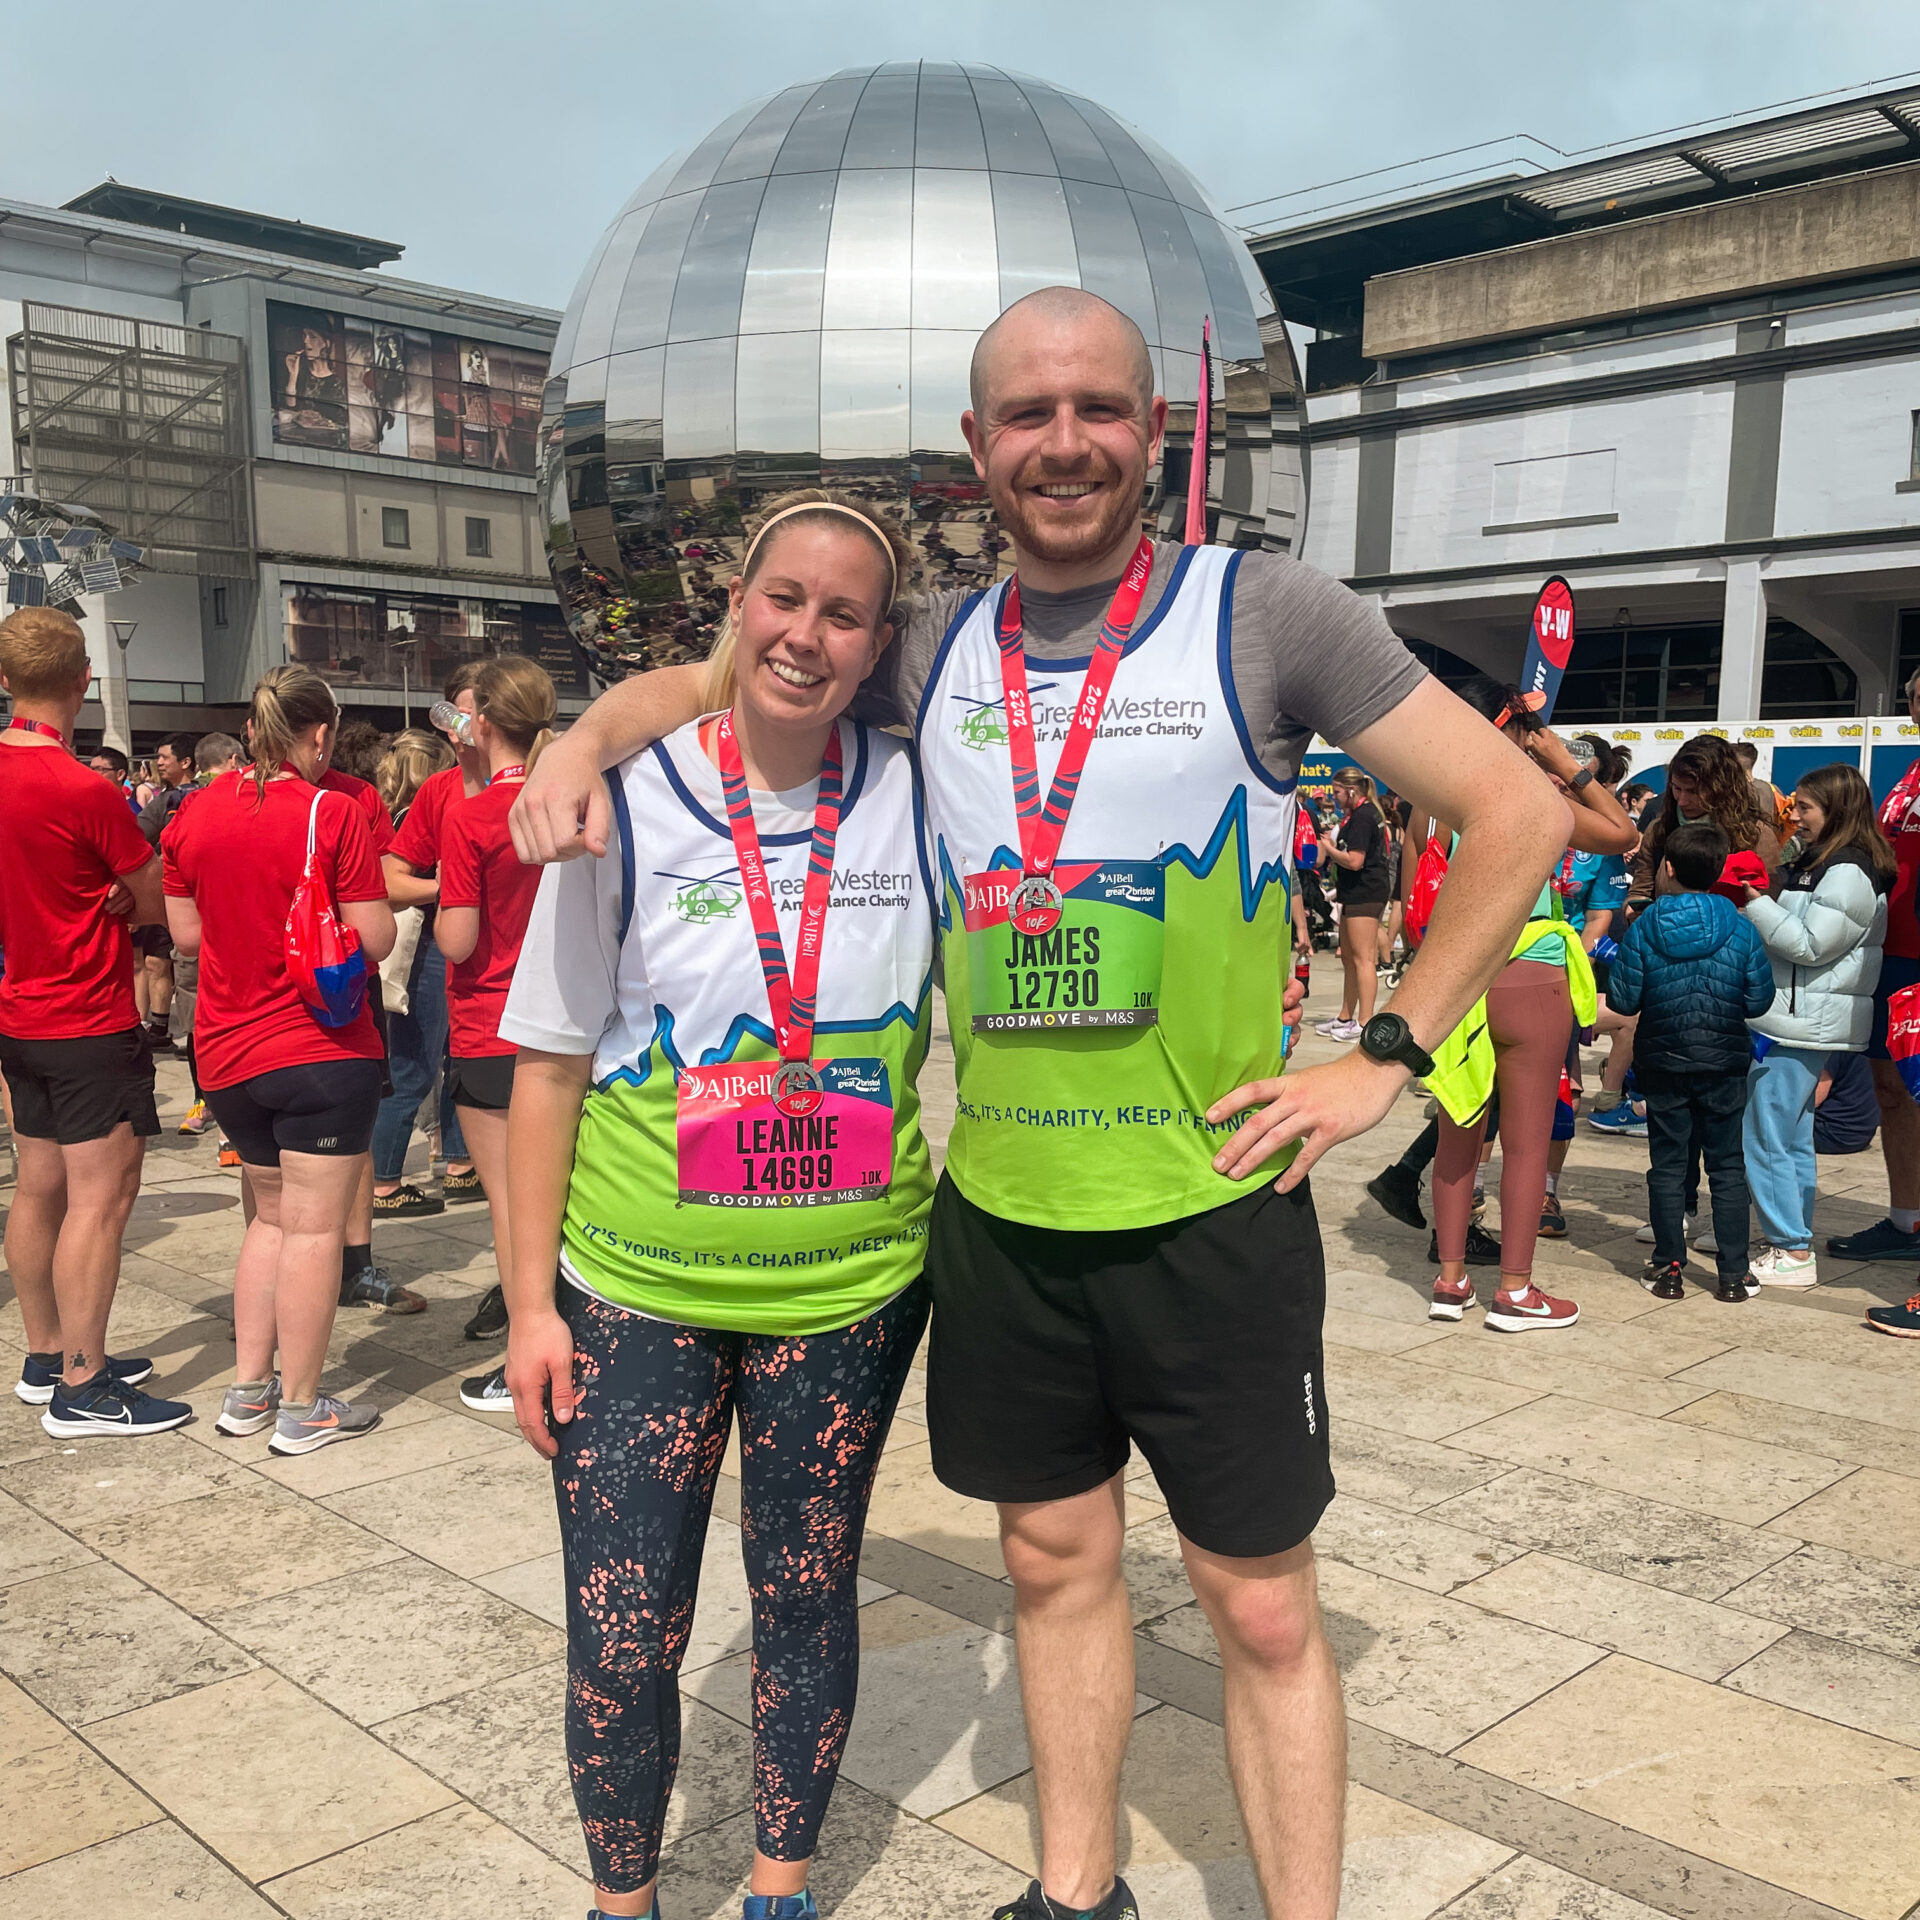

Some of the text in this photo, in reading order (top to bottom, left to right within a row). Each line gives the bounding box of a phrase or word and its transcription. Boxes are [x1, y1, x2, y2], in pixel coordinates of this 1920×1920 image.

[1009, 689, 1027, 727] 2023
[1030, 697, 1206, 725] Grea Western
[1079, 685, 1102, 729] 2023
[1034, 728, 1048, 742] ir
[1147, 722, 1203, 740] Charity
[1300, 763, 1332, 777] hat's
[743, 850, 763, 889] AJBell
[770, 868, 912, 896] rea Western
[1105, 873, 1133, 884] AJBell
[869, 894, 910, 911] Charity
[976, 884, 1026, 914] AJB
[1105, 887, 1155, 897] great bristol
[1026, 915, 1048, 930] 10K
[802, 916, 819, 957] AJBell
[1005, 927, 1100, 969] JAMES
[1009, 968, 1099, 1010] 12730
[1133, 992, 1152, 1008] 10K
[987, 1012, 1134, 1029] GOODMOVE by M&S
[837, 1067, 861, 1078] AJBell
[837, 1079, 880, 1089] great bristol
[703, 1074, 771, 1102] AJBell
[789, 1097, 811, 1112] 10K
[1005, 1107, 1013, 1120] A
[1016, 1106, 1111, 1131] CHARITY,
[1117, 1106, 1171, 1126] KEEP
[1178, 1108, 1188, 1125] IT
[736, 1115, 839, 1154] LEANNE
[742, 1154, 832, 1191] 14699
[861, 1170, 882, 1185] 10K
[709, 1189, 863, 1207] GOODMOVE by M&S
[623, 1239, 689, 1268] YOURS,
[731, 1253, 742, 1264] A
[747, 1247, 843, 1268] CHARITY,
[849, 1235, 893, 1256] KEEP
[897, 1229, 908, 1245] IT
[1304, 1372, 1316, 1435] adidas
